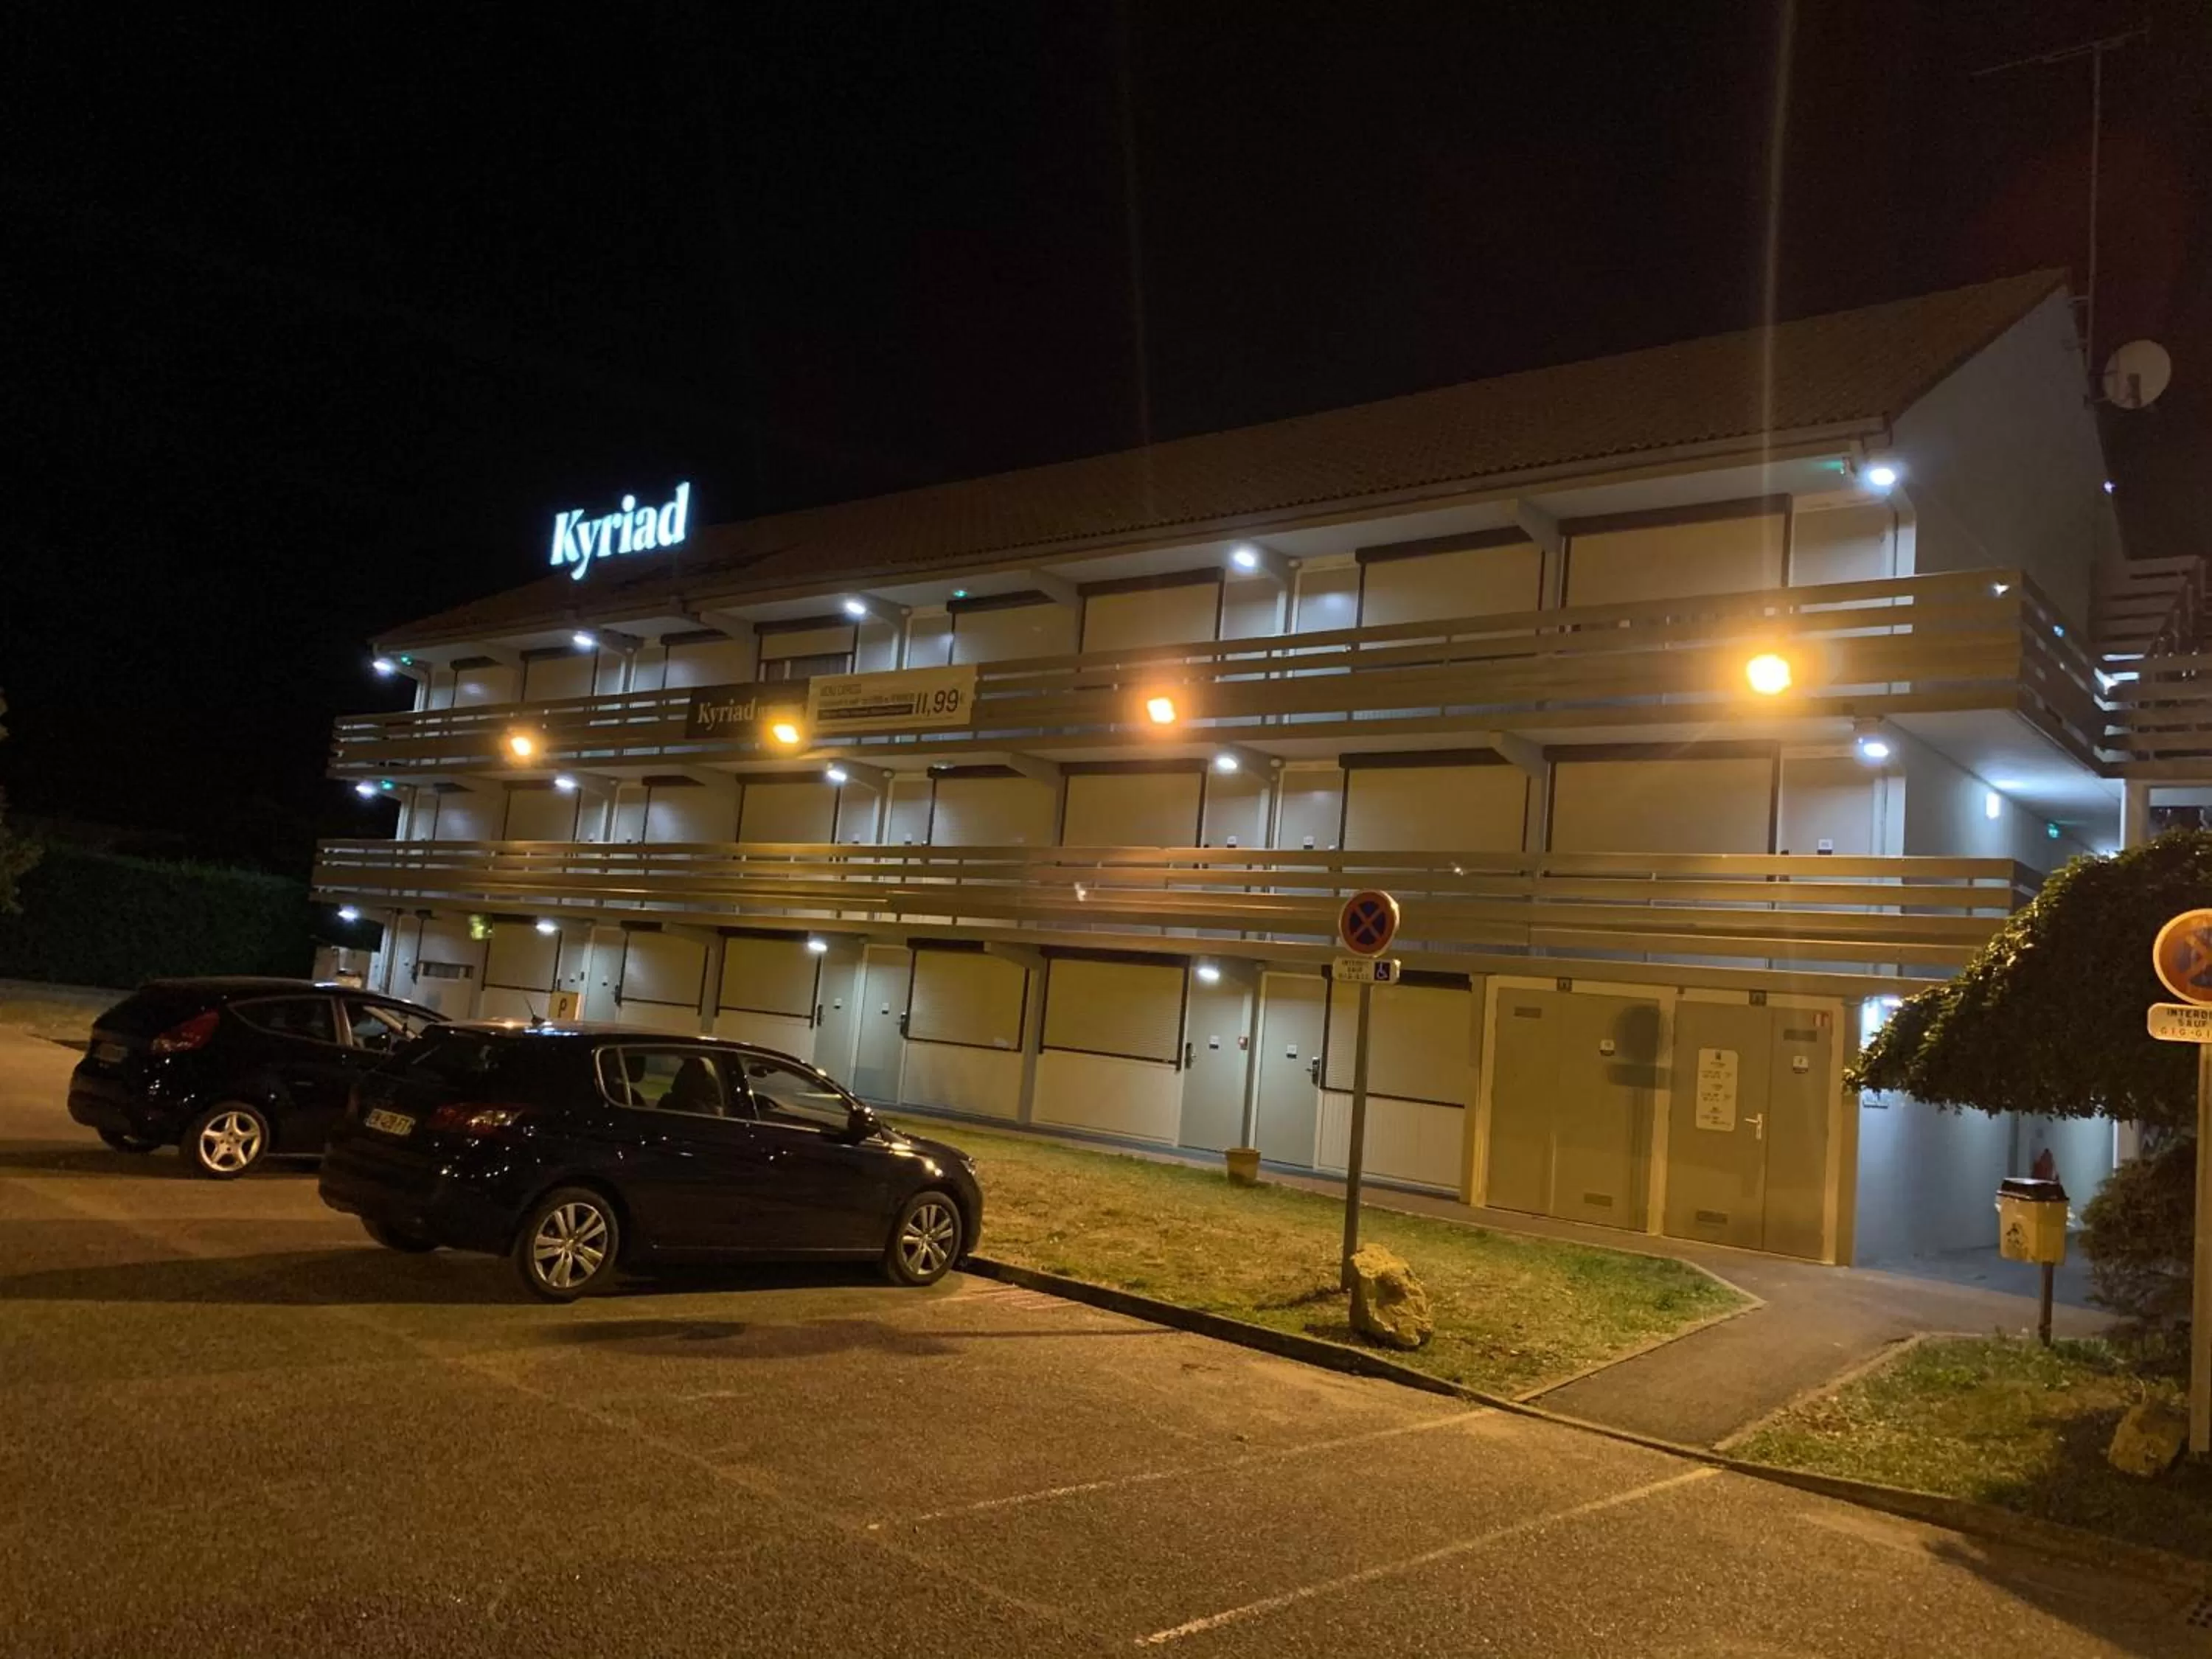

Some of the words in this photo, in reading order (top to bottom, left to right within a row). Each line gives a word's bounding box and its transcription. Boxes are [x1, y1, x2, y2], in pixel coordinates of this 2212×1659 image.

[550, 481, 690, 580] Kyriad
[698, 696, 757, 731] Kyriad
[2177, 1019, 2207, 1027] SAUF
